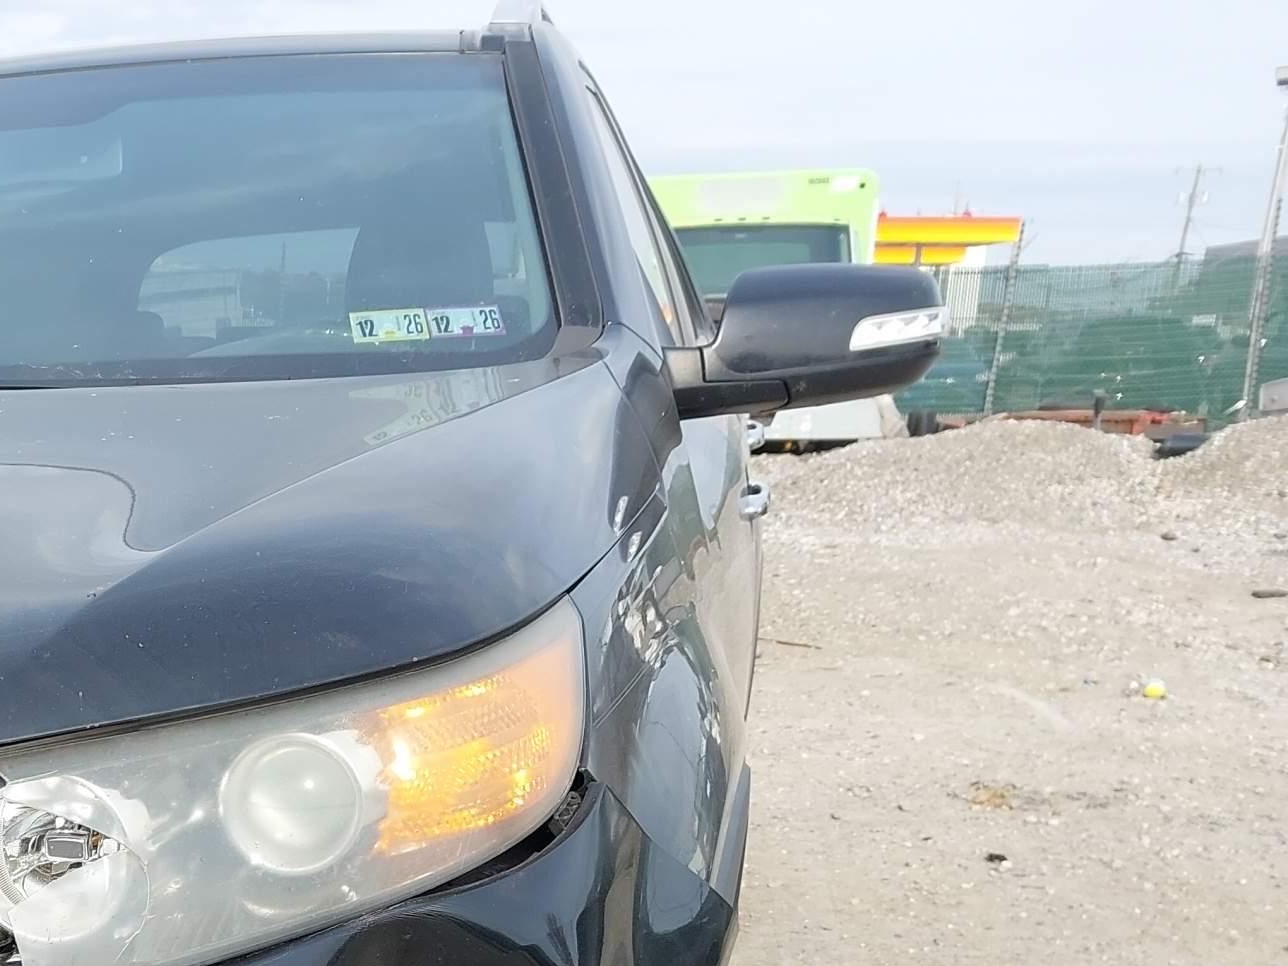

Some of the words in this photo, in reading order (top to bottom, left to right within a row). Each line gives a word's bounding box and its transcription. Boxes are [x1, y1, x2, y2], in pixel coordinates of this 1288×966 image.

[356, 319, 378, 338] 12
[404, 313, 424, 334] 26
[432, 315, 454, 334] 12
[480, 309, 501, 330] 26
